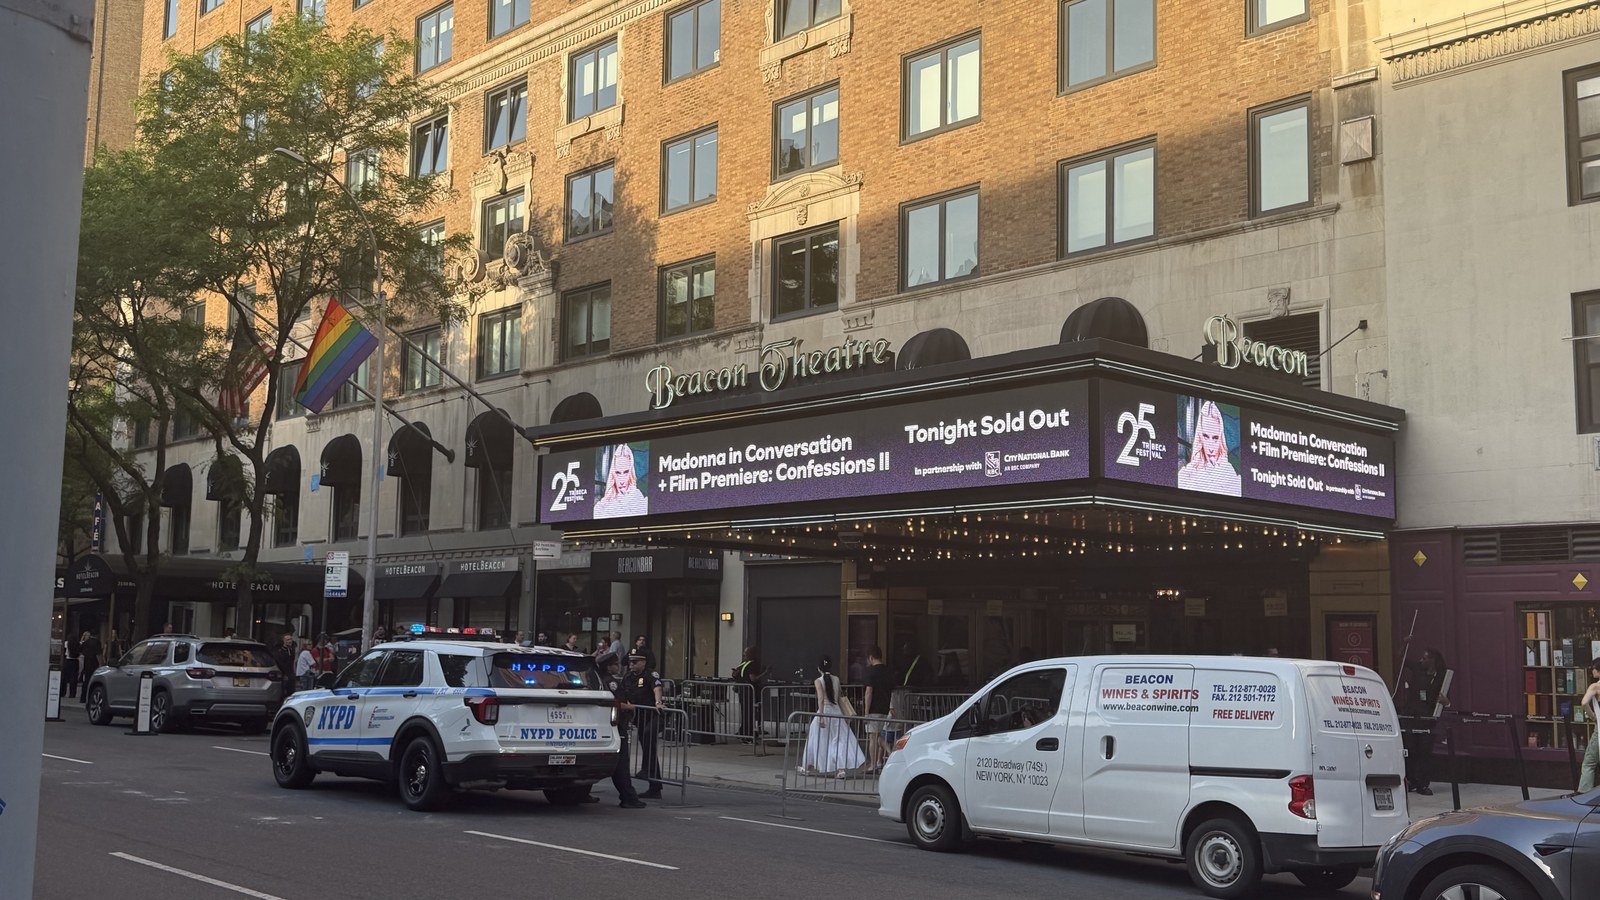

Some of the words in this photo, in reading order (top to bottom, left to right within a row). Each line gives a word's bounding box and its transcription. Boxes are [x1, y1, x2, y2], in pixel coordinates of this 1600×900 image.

[1203, 315, 1309, 377] Beacon
[645, 361, 748, 410] Beacon
[759, 334, 891, 392] Theatre
[905, 418, 977, 445] Tonight
[981, 410, 1025, 436] Sold
[1028, 408, 1070, 430] Out
[1116, 402, 1156, 467] 25
[1250, 421, 1298, 444] Madonna
[1299, 431, 1308, 446] in
[1309, 433, 1368, 458] Conversation
[658, 452, 727, 473] Madonna
[729, 446, 742, 465] in
[745, 434, 853, 463] Conversation
[1250, 441, 1258, 453] +
[1259, 441, 1280, 458] Film
[1281, 445, 1327, 467] Premiere:
[1327, 453, 1379, 477] Confessions
[658, 479, 667, 492] +
[669, 473, 699, 493] Film
[701, 467, 773, 489] Premiere:
[776, 456, 876, 481] Confessions
[915, 467, 922, 476] In
[922, 463, 965, 477] partnership
[965, 461, 982, 471] with
[550, 461, 580, 512] 25
[1250, 467, 1287, 488] Tonight
[1287, 473, 1306, 489] Sold
[1307, 477, 1324, 492] Out
[250, 583, 281, 592] EACON
[512, 663, 566, 673] NYPD
[1125, 674, 1174, 685] BEACON
[1102, 689, 1138, 699] WINES
[1141, 689, 1149, 700] &
[1152, 689, 1199, 700] SPIRITS
[1213, 684, 1228, 693] TEL.
[1229, 684, 1277, 694] 212-877-0028
[1342, 685, 1367, 694] BEACON
[1212, 693, 1227, 702] FAX.
[1331, 695, 1353, 706] WINES
[1359, 697, 1381, 709] SPIRITS
[550, 711, 567, 720] 4557
[1102, 702, 1199, 713] www.beaconwine.com
[1212, 709, 1233, 720] FREE
[1234, 709, 1275, 721] DELIVERY
[317, 705, 356, 730] NYPD
[520, 728, 554, 740] NYPD
[559, 728, 597, 740] POLICE
[976, 757, 992, 768] 2120
[993, 758, 1025, 773] Broadway
[976, 770, 992, 782] NEW
[993, 772, 1016, 784] YORK,
[1016, 773, 1027, 784] NY
[1028, 775, 1049, 786] 10023
